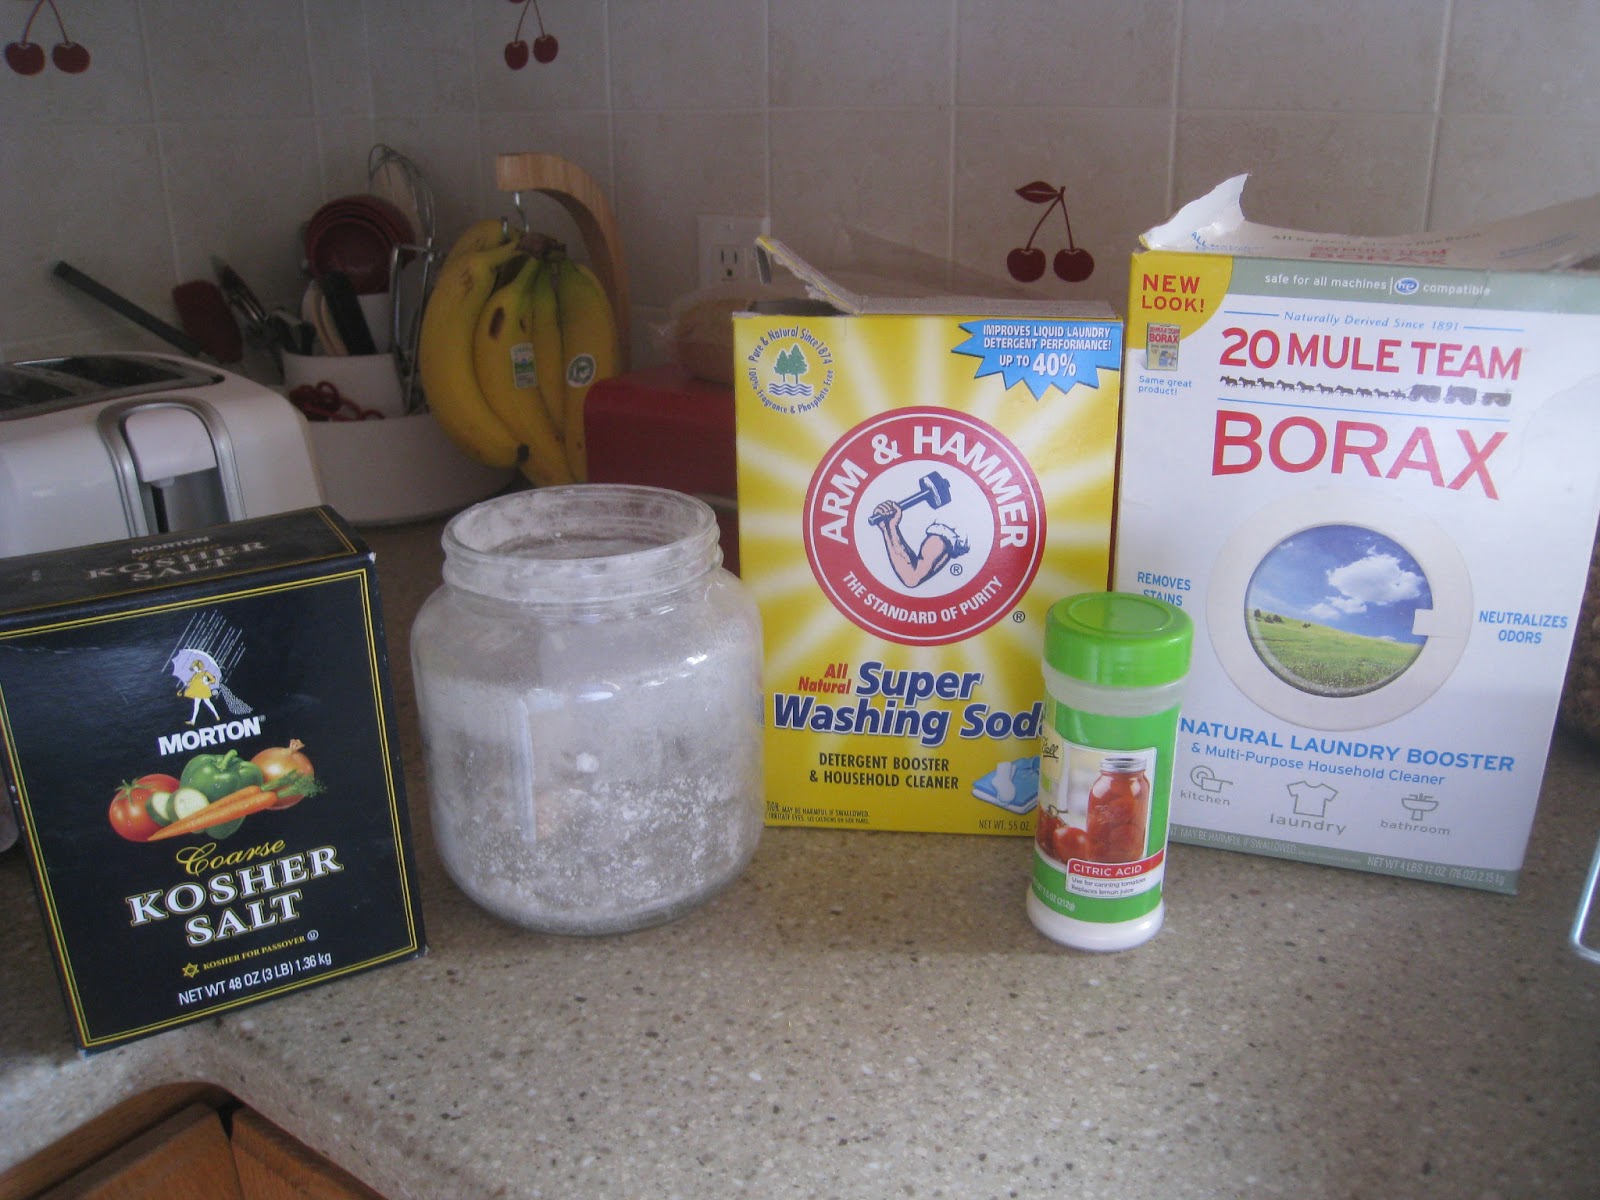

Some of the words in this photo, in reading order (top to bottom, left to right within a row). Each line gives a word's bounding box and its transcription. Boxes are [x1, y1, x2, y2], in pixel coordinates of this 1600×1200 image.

[1142, 273, 1200, 294] NEW
[1264, 273, 1289, 284] safe
[1293, 275, 1309, 286] for
[1313, 276, 1327, 287] all
[1331, 278, 1387, 290] machines
[1423, 282, 1491, 297] compatible
[1141, 295, 1205, 313] LOOK!
[983, 324, 1031, 336] IMPROVES
[1033, 325, 1064, 338] LIQUID
[1067, 326, 1111, 339] LAUNDRY
[1284, 311, 1340, 325] Naturally
[1344, 314, 1388, 328] Derived
[1394, 318, 1425, 329] Since
[1431, 320, 1459, 332] 1891
[748, 344, 764, 362] Pure
[760, 336, 770, 346] &
[767, 325, 799, 341] Natural
[800, 328, 819, 347] Since
[983, 338, 1037, 349] DETERGENT
[1040, 338, 1112, 350] PERFORMANCE!
[1149, 333, 1179, 344] BORAX
[1219, 327, 1281, 369] 20
[1287, 332, 1402, 373] MULE
[1411, 341, 1523, 381] TEAM
[999, 354, 1014, 367] UP
[1016, 355, 1030, 367] TO
[1032, 352, 1077, 378] 40%
[756, 389, 788, 413] Fragrance
[797, 386, 829, 413] Phosphate
[823, 369, 834, 386] Free
[1138, 385, 1177, 396] product!
[1139, 375, 1165, 385] Same
[1167, 379, 1192, 389] great
[1212, 409, 1508, 500] BORAX
[820, 458, 869, 545] ARM
[871, 433, 902, 465] &
[913, 425, 1029, 548] HAMMER
[131, 536, 210, 554] MORTON
[83, 541, 267, 580] KOSHER
[1137, 571, 1191, 591] REMOVES
[842, 571, 867, 598] THE
[863, 591, 938, 624] STANDARD
[941, 606, 958, 622] OF
[961, 575, 1003, 616] PURITY
[1479, 611, 1568, 629] NEUTRALIZES
[1498, 629, 1542, 644] ODORS
[824, 663, 848, 679] All
[798, 676, 851, 695] Natural
[855, 661, 983, 708] Super
[773, 693, 952, 747] Washing
[959, 702, 1043, 740] Sod
[158, 716, 262, 756] MORTON
[1180, 717, 1284, 748] NATURAL
[1290, 735, 1401, 761] LAUNDRY
[1406, 748, 1515, 772] BOOSTER
[819, 752, 888, 770] DETERGENT
[893, 756, 949, 772] BOOSTER
[1191, 742, 1201, 753] &
[1205, 744, 1304, 769] Multi-Purpose
[1308, 760, 1385, 779] Household
[1388, 769, 1446, 785] Cleaner
[809, 770, 819, 783] &
[823, 770, 900, 787] HOUSEHOLD
[905, 774, 959, 790] CLEANER
[1180, 789, 1231, 806] kitchen
[979, 819, 991, 829] NET
[1008, 821, 1018, 831] 55
[1180, 827, 1196, 839] MAY
[1269, 813, 1347, 836] laundry
[1380, 819, 1451, 836] bathroom
[176, 839, 286, 876] Coarse
[1367, 856, 1384, 868] NET
[1385, 858, 1398, 870] WT
[1406, 861, 1423, 873] LBS
[1073, 863, 1112, 877] CITRIC
[1115, 864, 1142, 876] ACID
[125, 845, 344, 927] KOSHER
[1071, 876, 1083, 885] Use
[1094, 880, 1120, 888] canning
[184, 889, 303, 947] SALT
[203, 954, 241, 970] KOSHER
[242, 949, 260, 960] FOR
[261, 935, 306, 954] PASSOVER
[178, 986, 203, 1006] NET
[205, 981, 226, 998] WT
[228, 976, 242, 991] 48
[243, 970, 261, 987] OZ
[262, 967, 273, 983] (3
[274, 960, 294, 978] LB)
[295, 954, 317, 971] 1.36
[317, 951, 332, 966] kg
